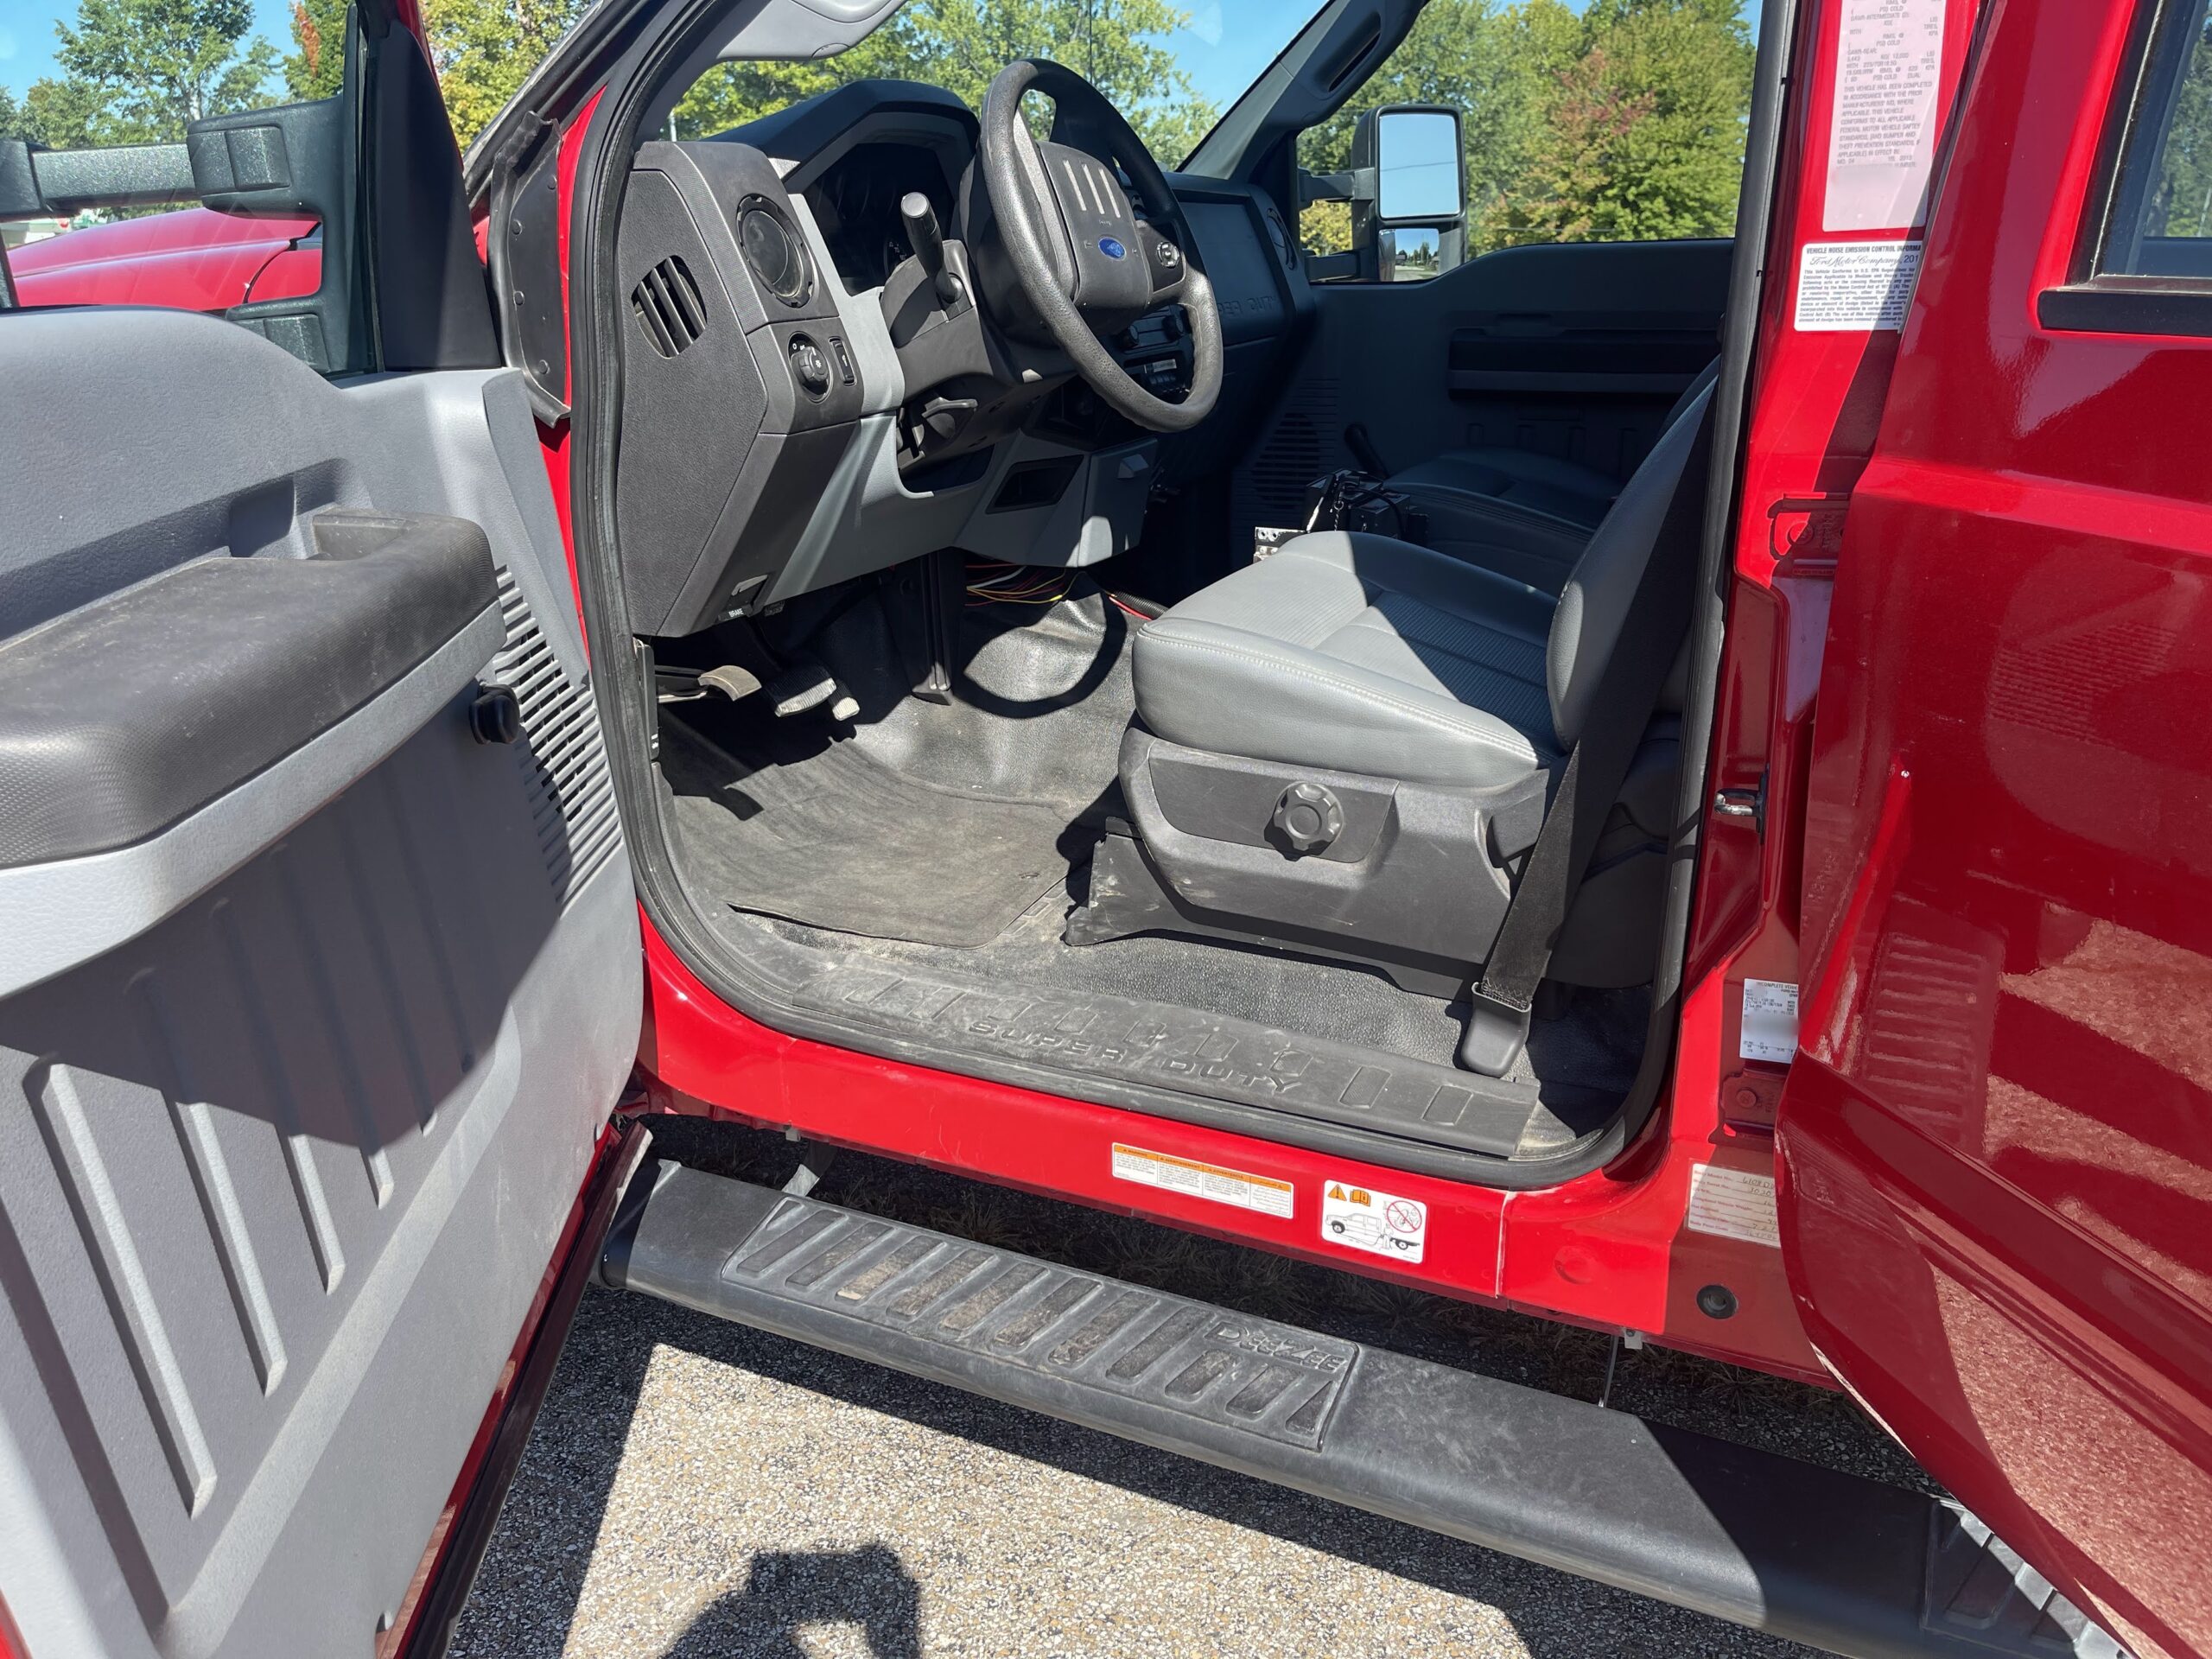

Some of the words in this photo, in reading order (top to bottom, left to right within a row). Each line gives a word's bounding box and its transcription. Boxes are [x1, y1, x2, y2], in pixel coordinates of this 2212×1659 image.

[1809, 257, 1832, 265] Ford
[1828, 257, 1857, 267] Motor
[728, 608, 744, 618] BRAKE
[969, 1021, 1128, 1063] SUPER
[1160, 1058, 1303, 1095] DUTY
